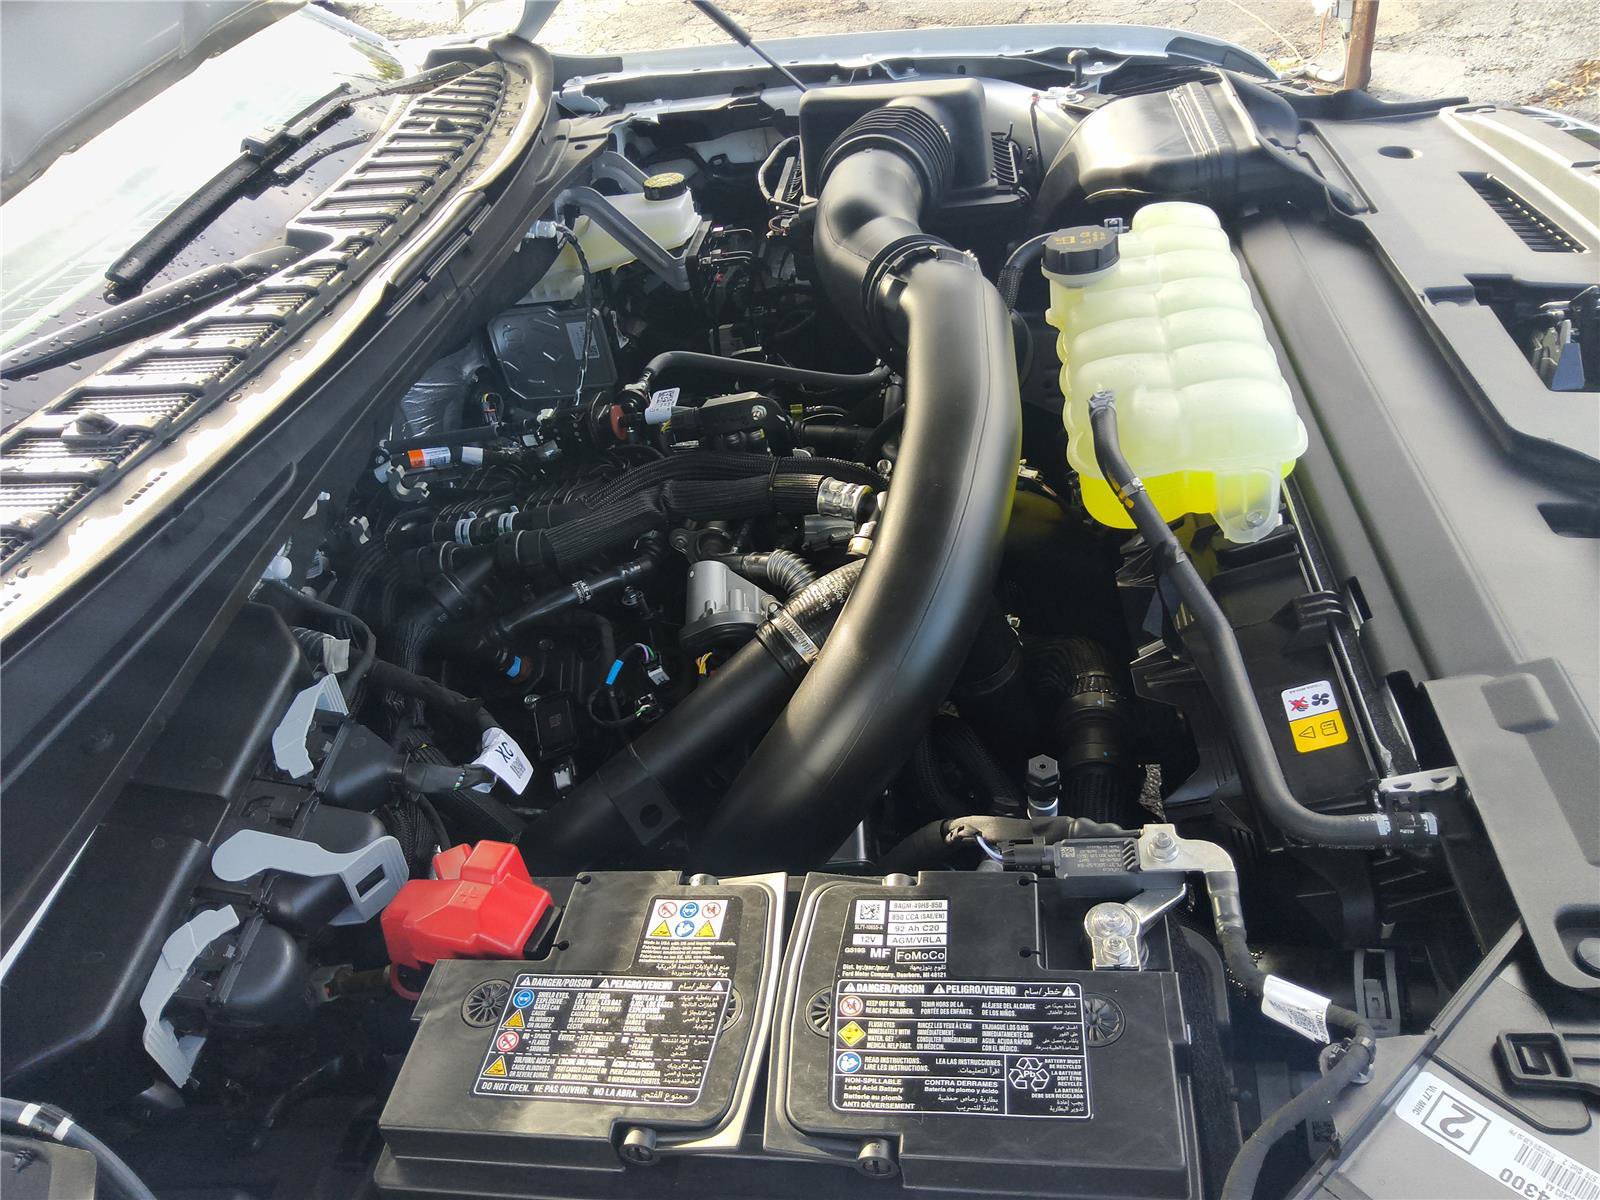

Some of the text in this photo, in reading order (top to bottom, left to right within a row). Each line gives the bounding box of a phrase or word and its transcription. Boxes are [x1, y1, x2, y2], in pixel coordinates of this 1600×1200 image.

[495, 741, 514, 764] XC
[892, 913, 905, 921] 850
[920, 912, 945, 920] (SAE/EN)
[892, 936, 942, 944] AGM/VRLA
[870, 947, 891, 958] MF
[897, 950, 945, 960] FoMoCo
[530, 977, 593, 988] DANGER/POISON
[609, 980, 673, 991] PELIGRO/VENENO
[856, 983, 925, 993] DANGER/POISON
[946, 984, 1016, 995] PELIGRO/VENENO
[864, 1056, 922, 1065] READ INSTRUCTIONS.
[946, 1058, 957, 1066] LAS
[958, 1059, 1003, 1067] INSTRUCCIONES.
[888, 1064, 930, 1072] INSTRUCTIONS.
[1023, 1070, 1036, 1078] Pb
[844, 1077, 902, 1085] NON-SPILLABLE
[956, 1080, 999, 1088] DERRAMES
[481, 1082, 492, 1090] DO
[509, 1083, 529, 1092] OPEN.
[533, 1084, 543, 1092] NE
[544, 1085, 559, 1093] PAS
[878, 1085, 904, 1093] Battery
[593, 1088, 639, 1098] NO LA ABRA.
[843, 1092, 870, 1100] Batterie
[880, 1094, 903, 1102] plomb
[860, 1100, 916, 1110] DÉVERSEMENT
[1439, 1103, 1476, 1139] 2
